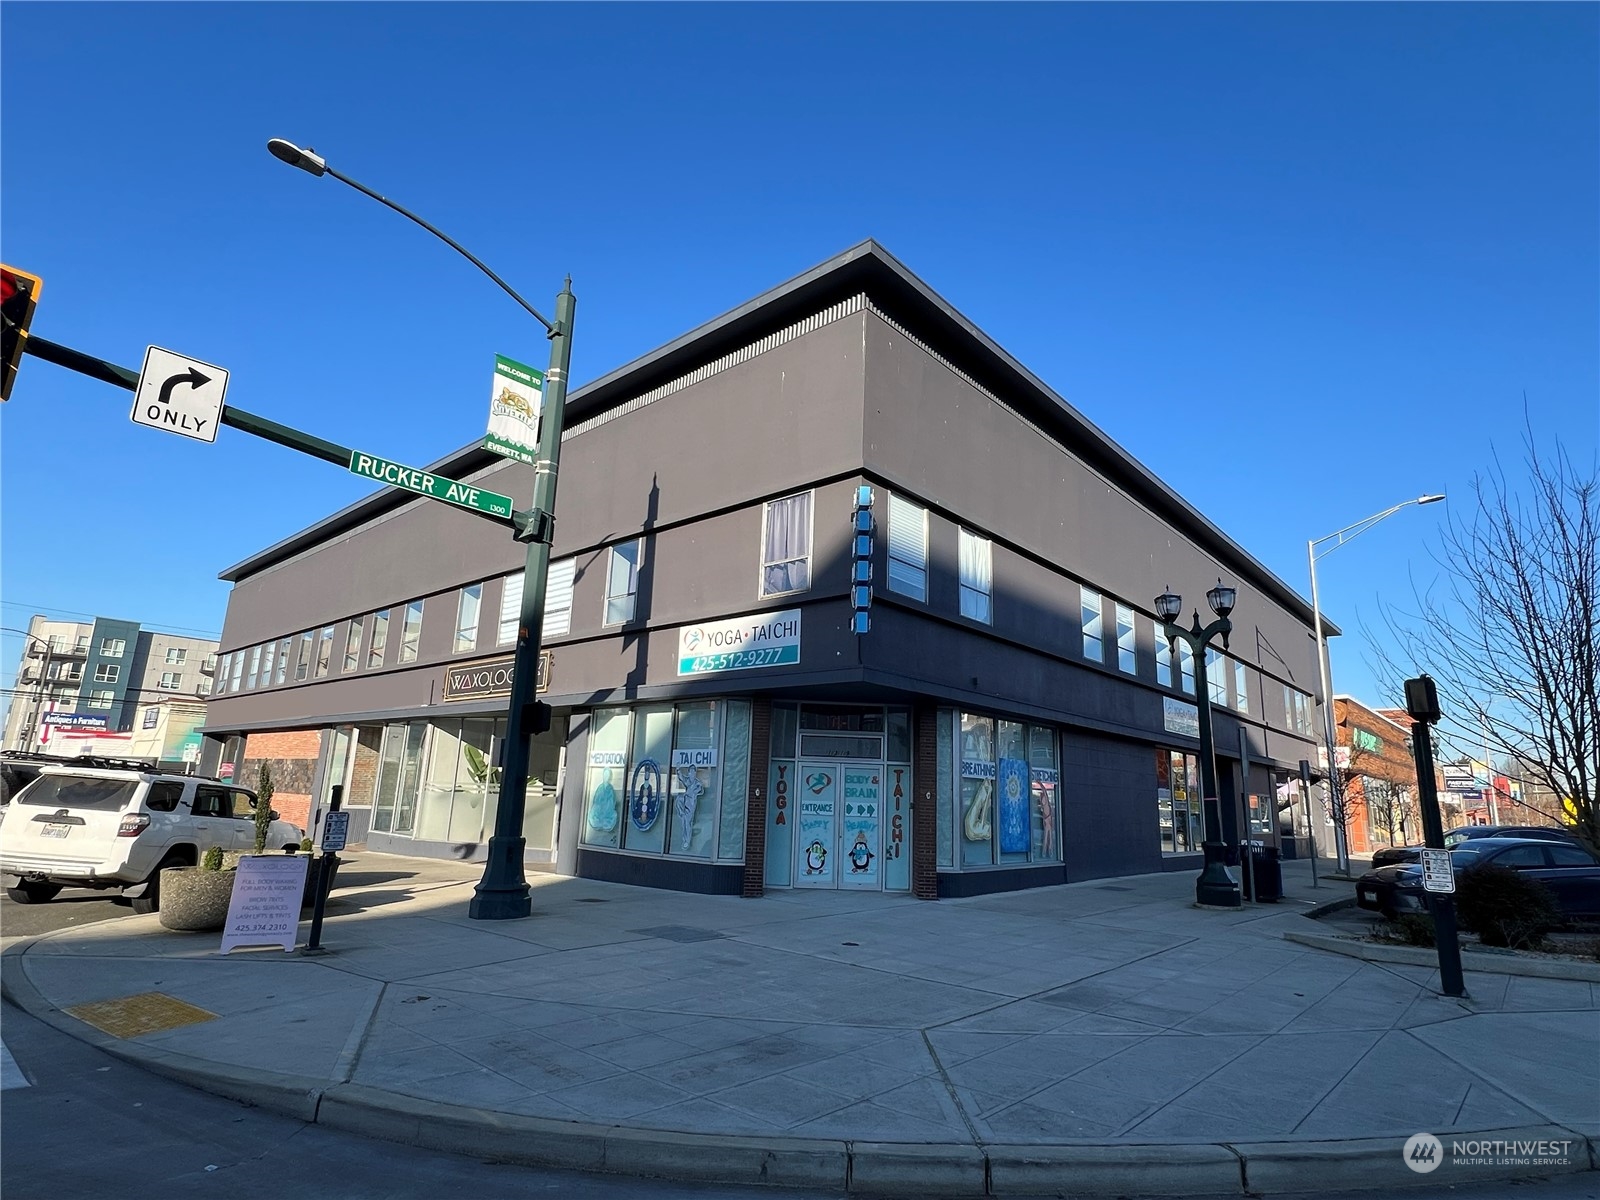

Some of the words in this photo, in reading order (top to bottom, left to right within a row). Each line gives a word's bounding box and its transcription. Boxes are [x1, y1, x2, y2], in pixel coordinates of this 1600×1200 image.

[497, 362, 531, 381] WELCOME
[531, 376, 541, 386] TO
[147, 405, 207, 432] ONLY
[487, 441, 520, 461] EVERETT,
[521, 454, 532, 463] WA
[357, 455, 435, 494] RUCKER
[446, 483, 480, 507] AVE
[490, 503, 506, 514] 1300
[707, 629, 743, 647] YOGA
[691, 647, 783, 672] 425-512-9277
[45, 716, 72, 726] Antiques
[77, 718, 106, 726] Furniture
[591, 752, 626, 765] MEDITATION
[680, 752, 693, 764] TAI
[695, 752, 711, 764] CHI
[845, 774, 870, 784] BODY
[871, 775, 879, 784] &
[962, 762, 995, 777] BREATHING
[775, 765, 788, 826] YOGA
[845, 787, 877, 799] BRAIN
[893, 769, 904, 811] TAI
[802, 803, 833, 814] ENTRANCE
[891, 814, 903, 858] CHI
